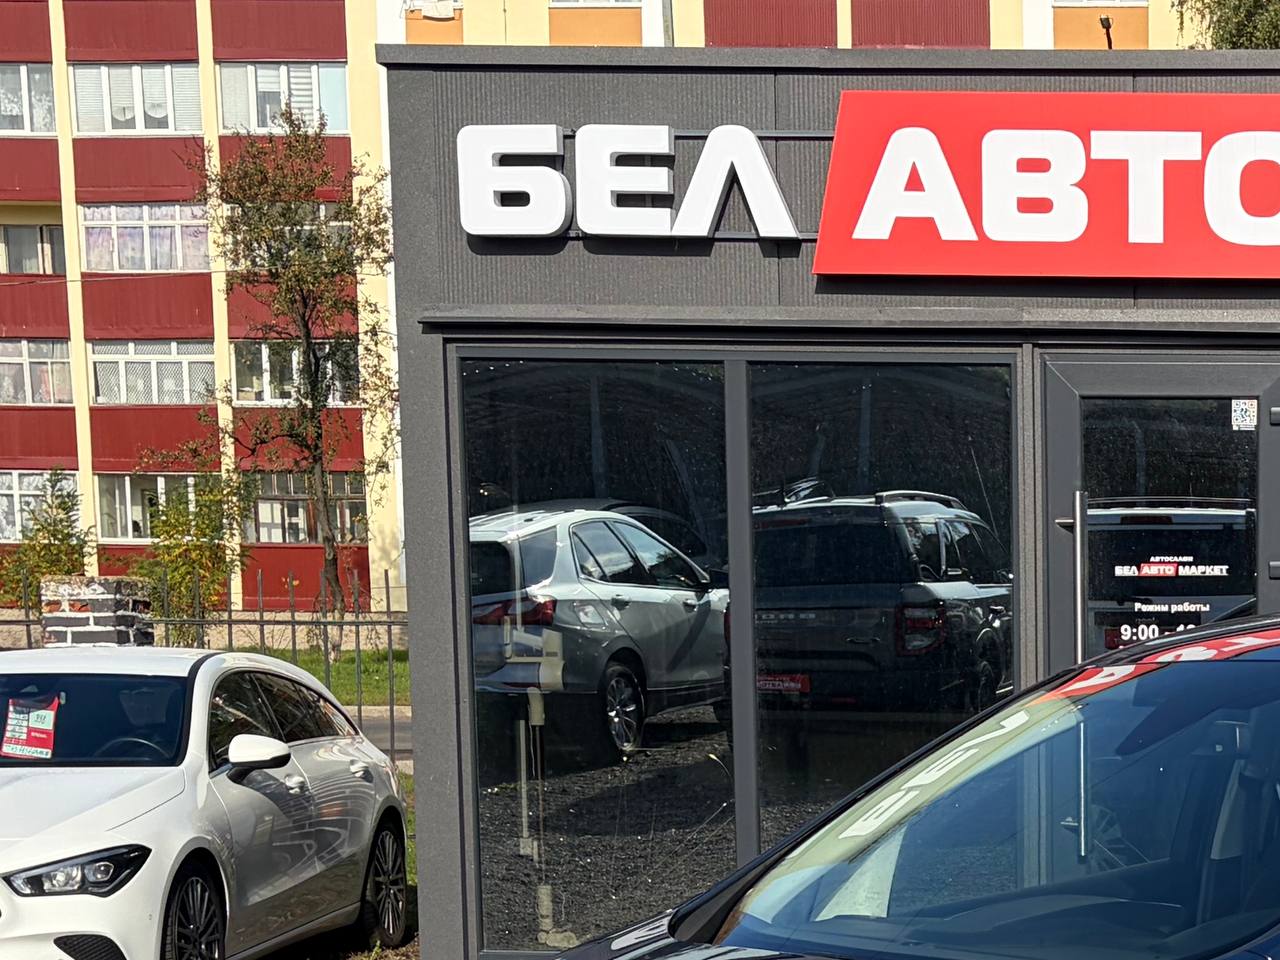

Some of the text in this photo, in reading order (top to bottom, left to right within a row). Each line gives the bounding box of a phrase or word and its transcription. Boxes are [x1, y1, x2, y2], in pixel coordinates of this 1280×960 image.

[457, 124, 799, 239] БЕЛ
[1114, 565, 1229, 576] БЕЛ АВТО МАРКЕТ
[1170, 602, 1210, 613] работы
[1120, 624, 1160, 641] 9:00
